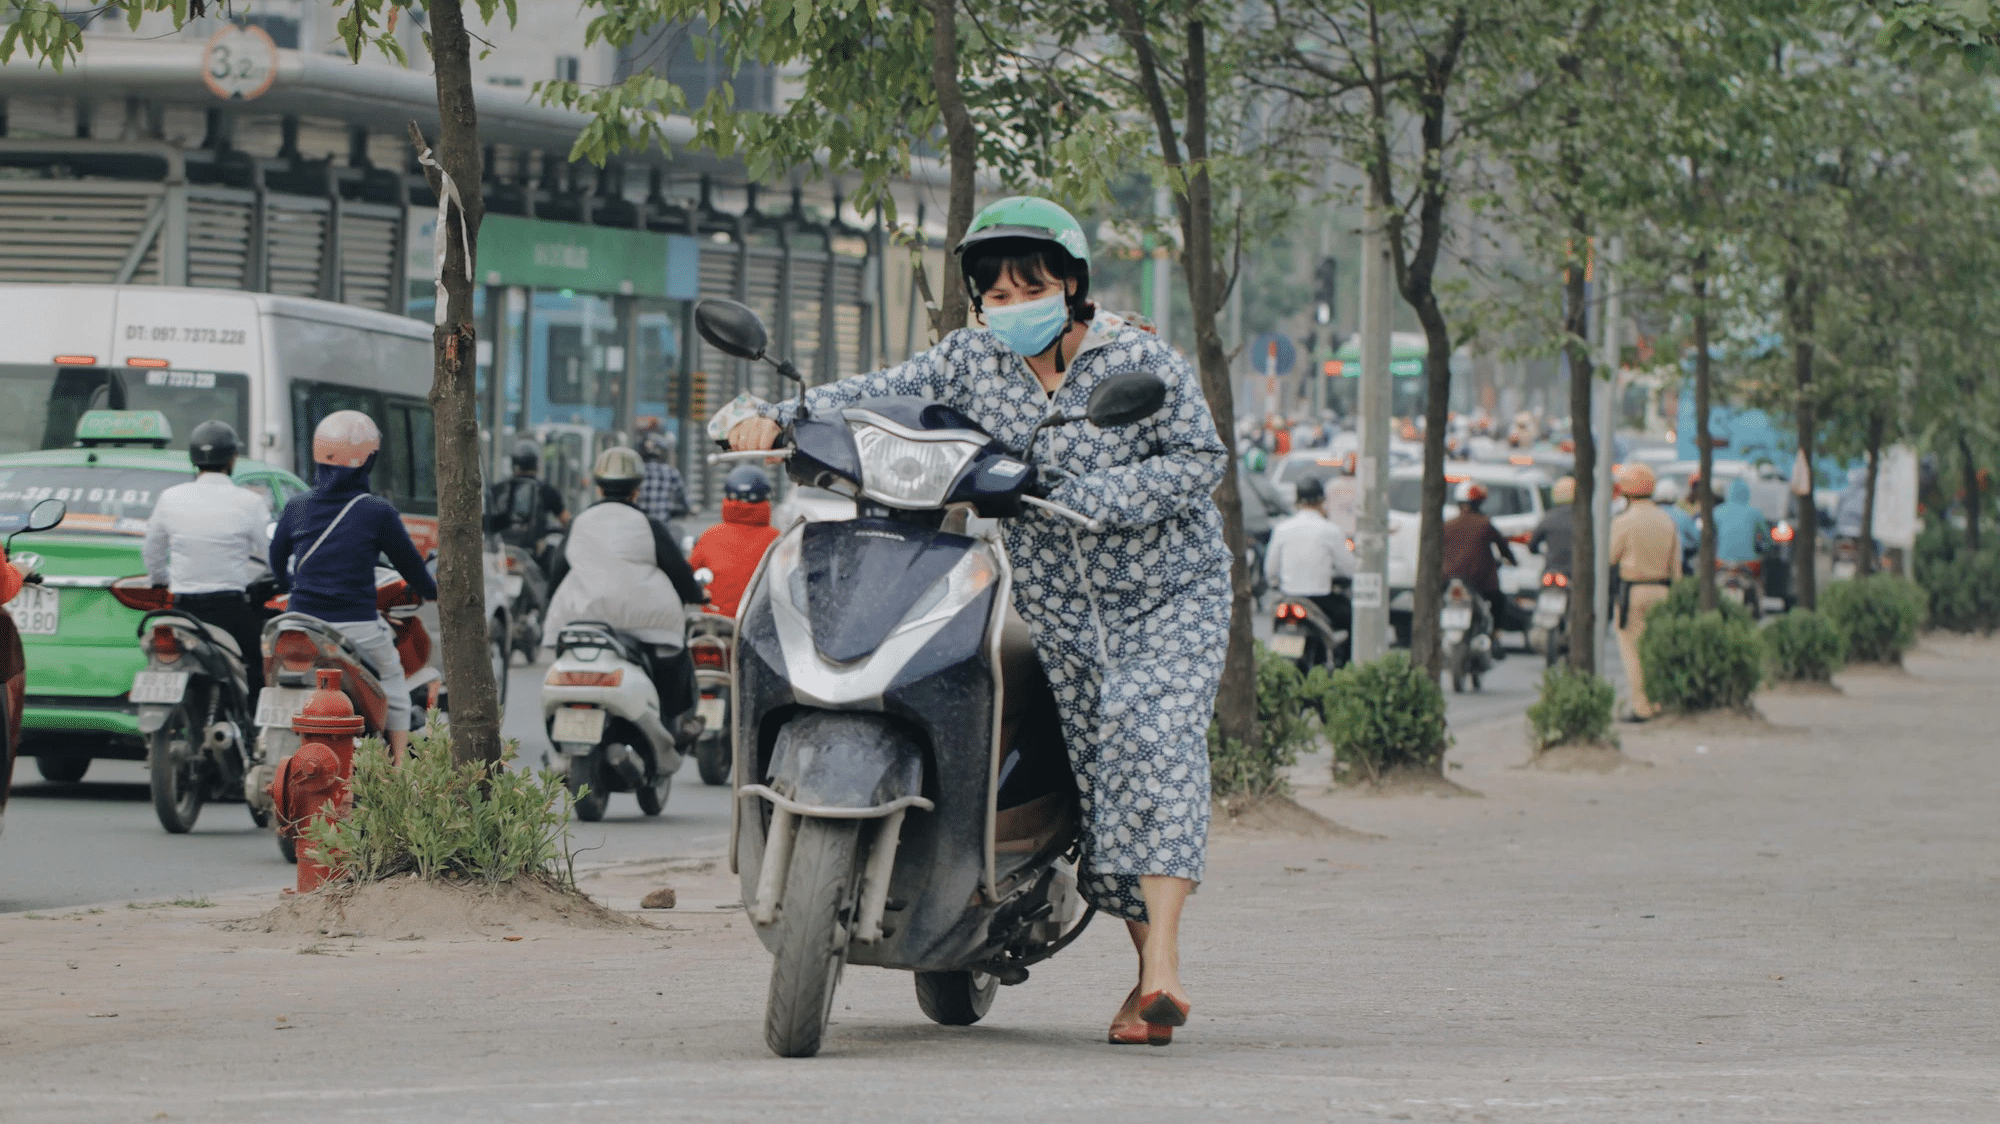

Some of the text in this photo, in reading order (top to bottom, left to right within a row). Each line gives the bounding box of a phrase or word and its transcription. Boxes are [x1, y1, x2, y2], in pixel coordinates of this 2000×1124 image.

[55, 487, 84, 502] 61
[88, 487, 117, 503] 61
[121, 489, 150, 505] 61
